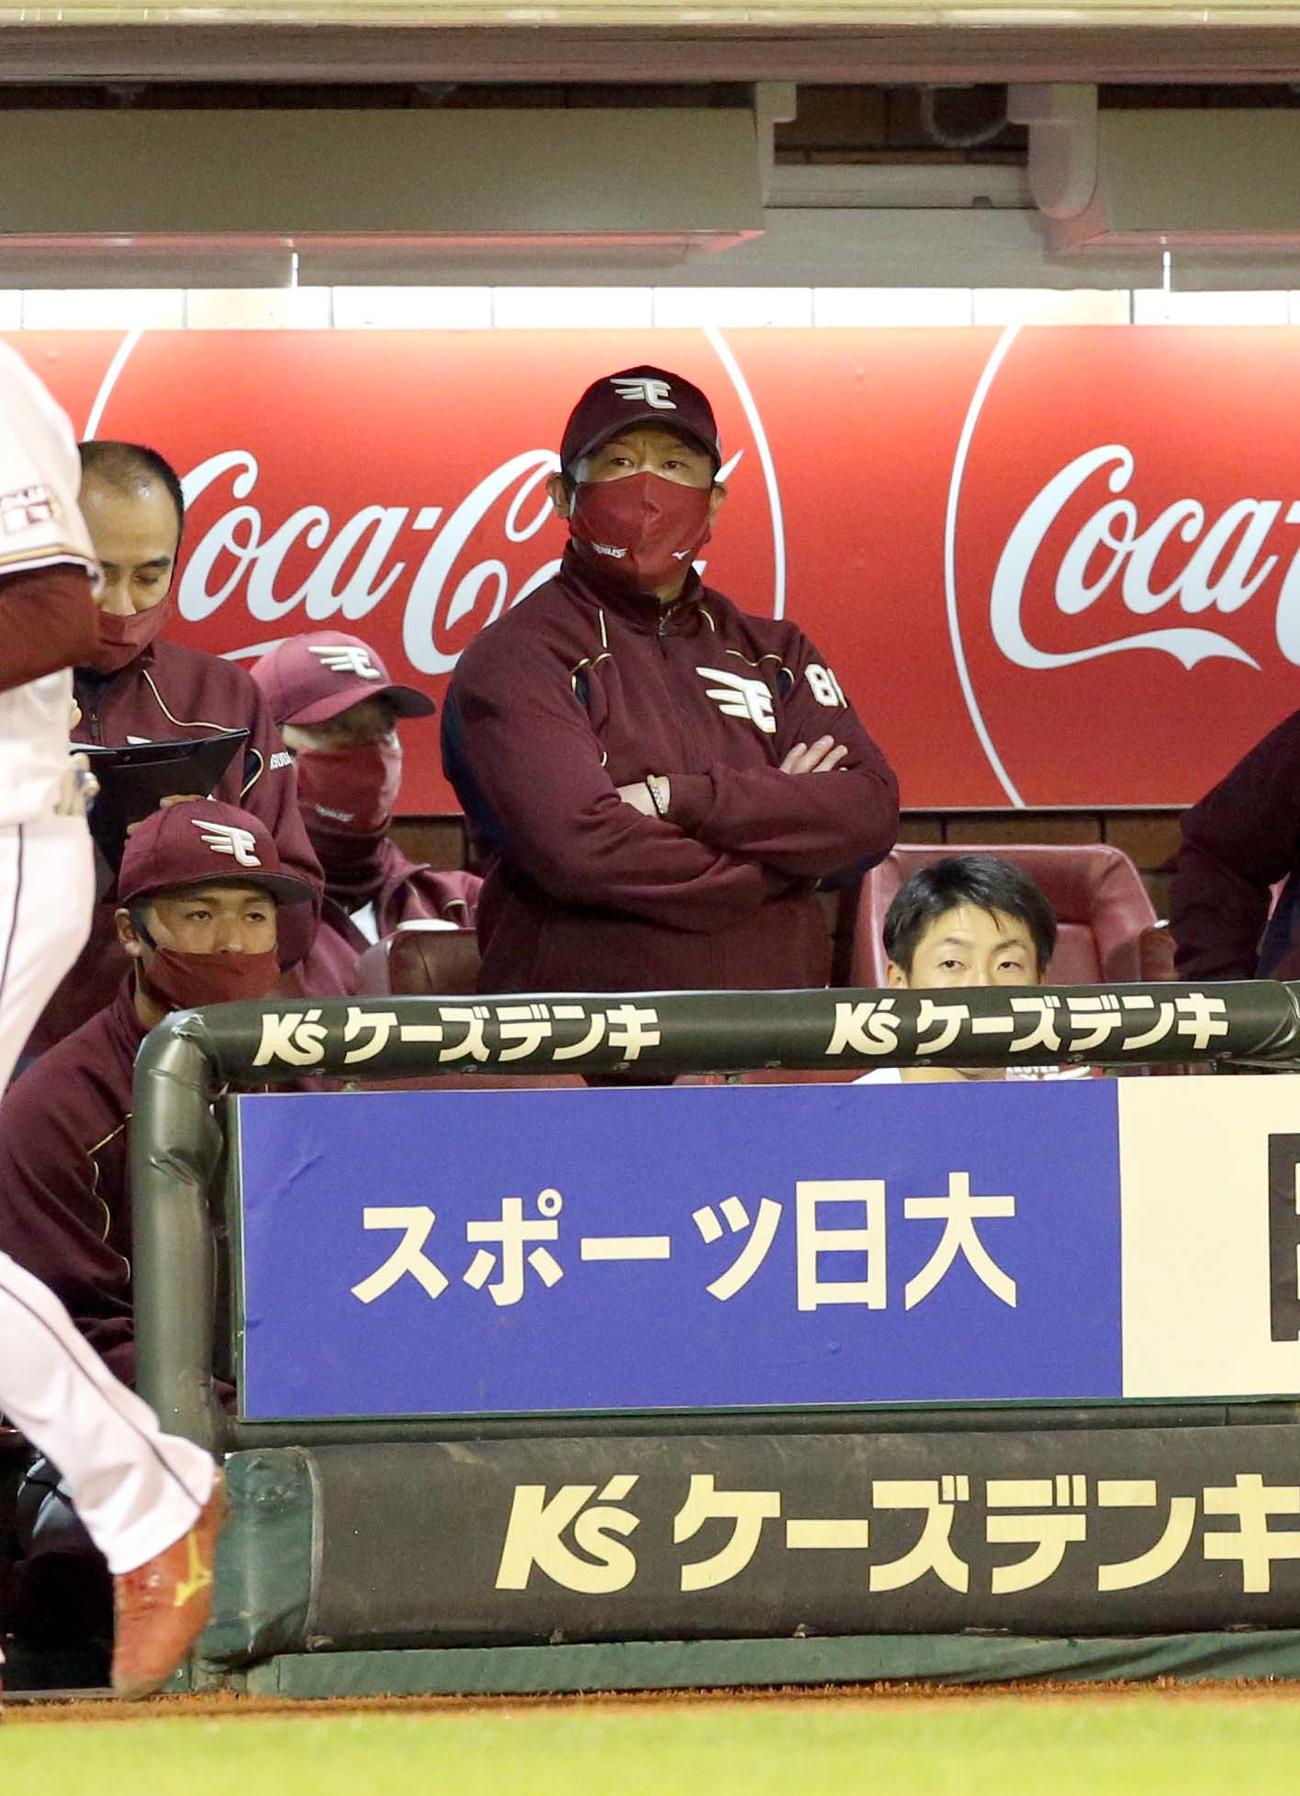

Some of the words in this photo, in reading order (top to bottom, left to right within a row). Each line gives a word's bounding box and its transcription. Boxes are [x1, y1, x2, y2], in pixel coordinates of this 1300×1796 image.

[804, 663, 848, 709] 8
[344, 1000, 661, 1064] ケーズデンキ
[915, 992, 1229, 1054] ケーズデンキ
[350, 1171, 1017, 1312] スポーツ日大
[674, 1473, 1300, 1594] ケーズデンキ
